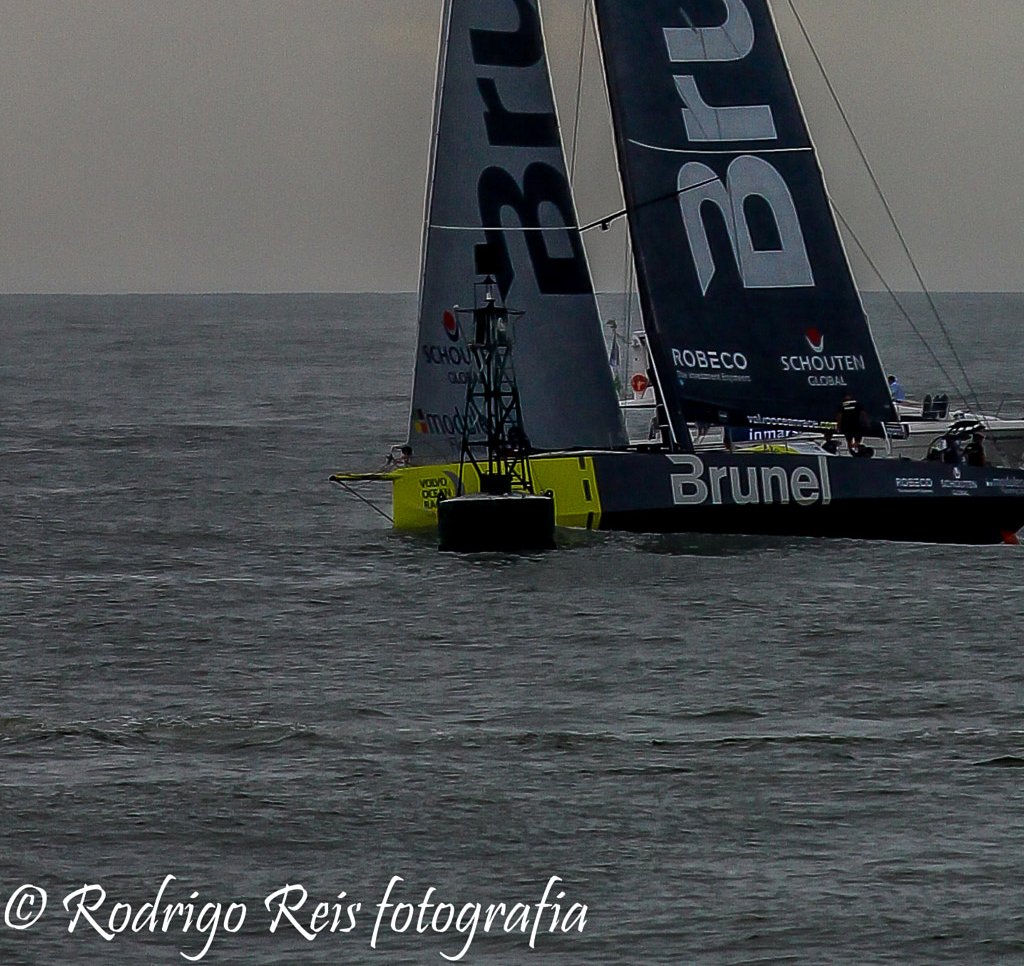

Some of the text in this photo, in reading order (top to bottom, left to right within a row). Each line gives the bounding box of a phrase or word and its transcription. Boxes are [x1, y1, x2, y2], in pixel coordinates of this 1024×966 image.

[671, 347, 748, 370] ROBECO
[780, 354, 865, 372] SCHOUTEN
[807, 374, 847, 386] GLOBAL
[666, 454, 832, 506] Brunel
